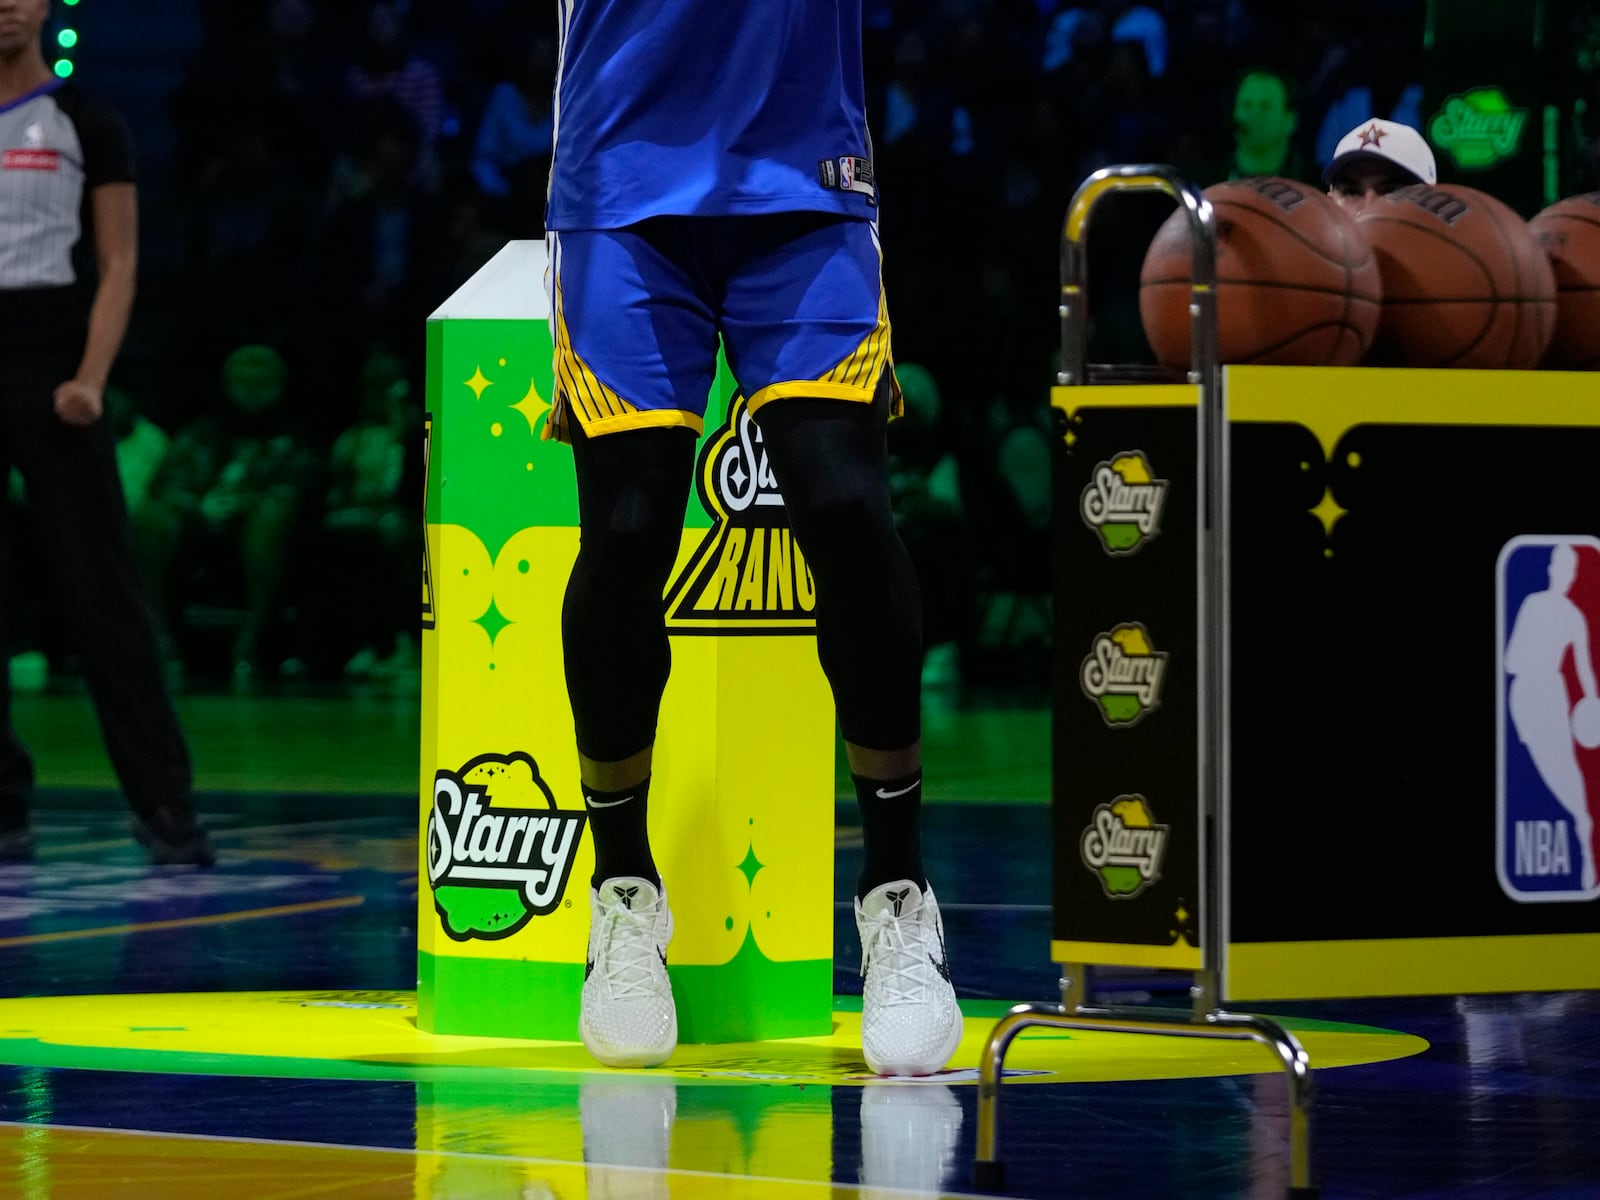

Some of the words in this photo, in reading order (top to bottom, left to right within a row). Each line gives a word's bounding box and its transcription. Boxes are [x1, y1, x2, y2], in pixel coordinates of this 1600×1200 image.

[1084, 467, 1162, 534] Starry
[693, 527, 816, 613] RANG
[1084, 638, 1162, 705] Starry
[428, 778, 578, 907] Starry
[1084, 809, 1162, 878] Starry
[1515, 820, 1571, 876] NBA
